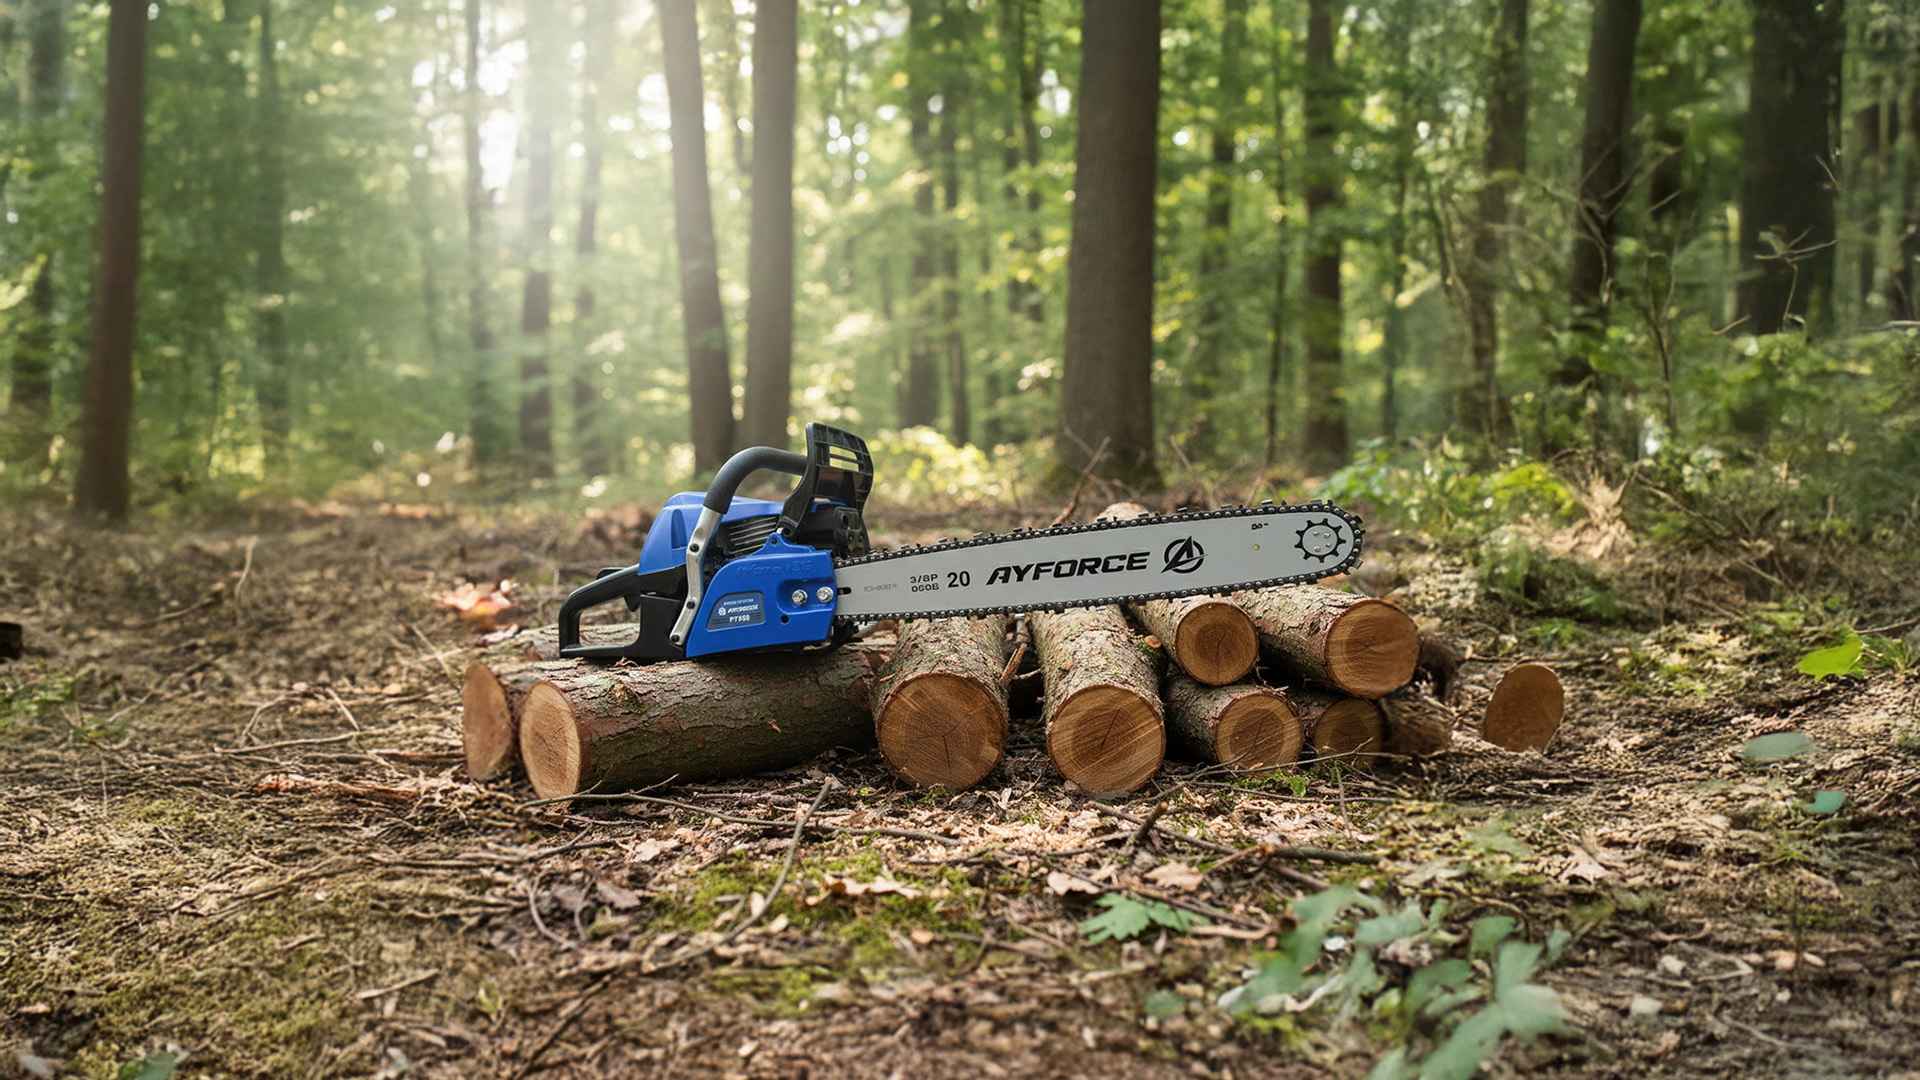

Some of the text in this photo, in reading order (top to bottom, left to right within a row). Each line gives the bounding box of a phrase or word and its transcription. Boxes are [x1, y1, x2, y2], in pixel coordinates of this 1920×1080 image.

[985, 551, 1150, 585] AYFORCE
[909, 573, 939, 584] 3/8P
[947, 570, 971, 588] 20
